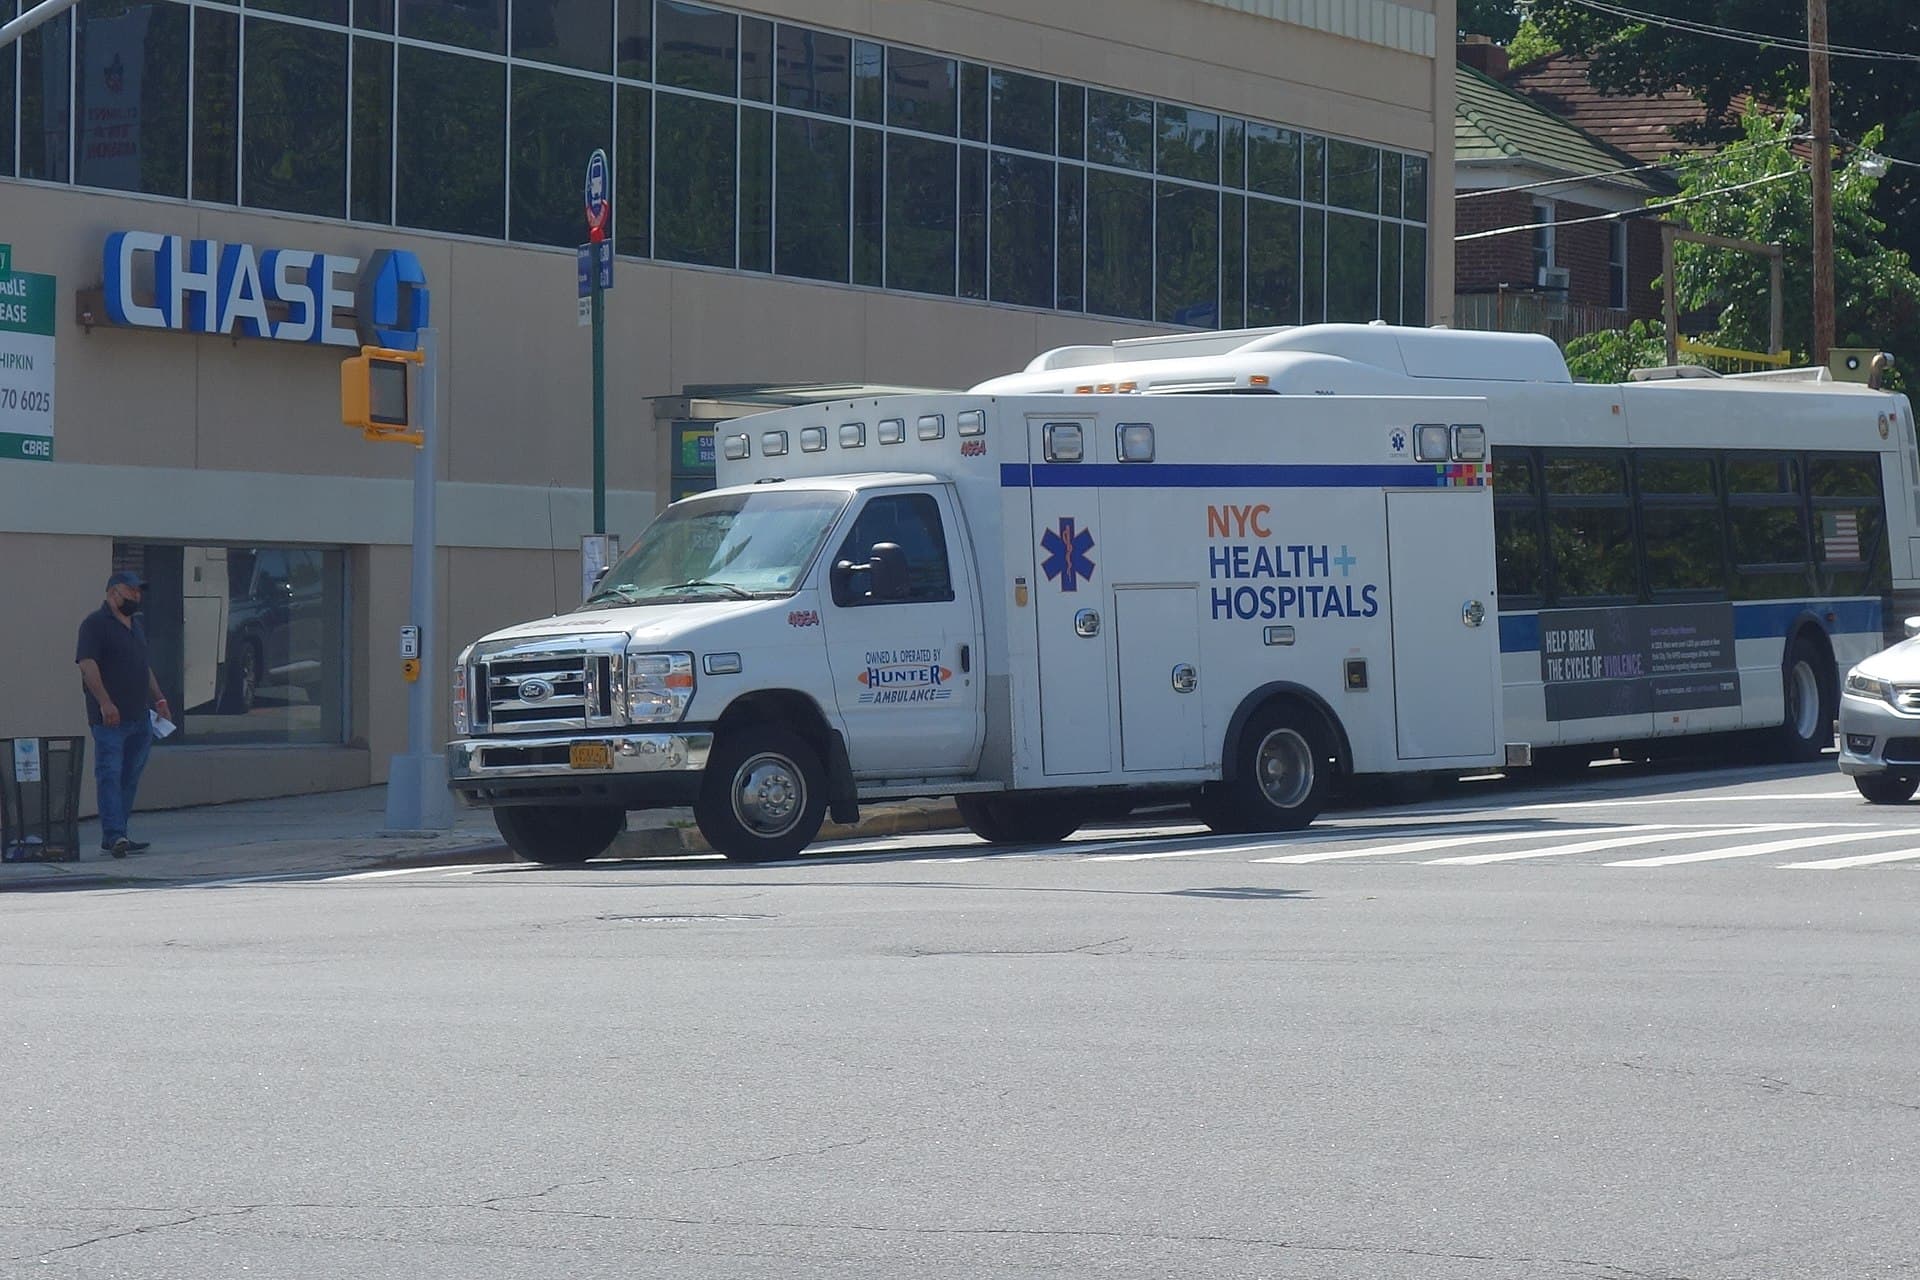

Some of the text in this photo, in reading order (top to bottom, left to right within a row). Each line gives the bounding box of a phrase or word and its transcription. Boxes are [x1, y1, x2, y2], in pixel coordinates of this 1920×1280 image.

[105, 229, 361, 347] CHASE
[20, 390, 50, 412] 6025
[22, 440, 50, 456] CBRE
[1207, 504, 1272, 538] NYC
[1211, 584, 1378, 620] HOSPITALS
[1545, 628, 1596, 654] HELP BREAK
[865, 650, 890, 665] OWNED
[900, 648, 931, 663] OPERATED
[933, 648, 941, 662] BY
[1547, 658, 1564, 681] THE
[1565, 656, 1590, 680] CYCLE
[1591, 655, 1603, 678] OF
[867, 664, 941, 689] HUNTER
[873, 688, 936, 704] AMBULANCE
